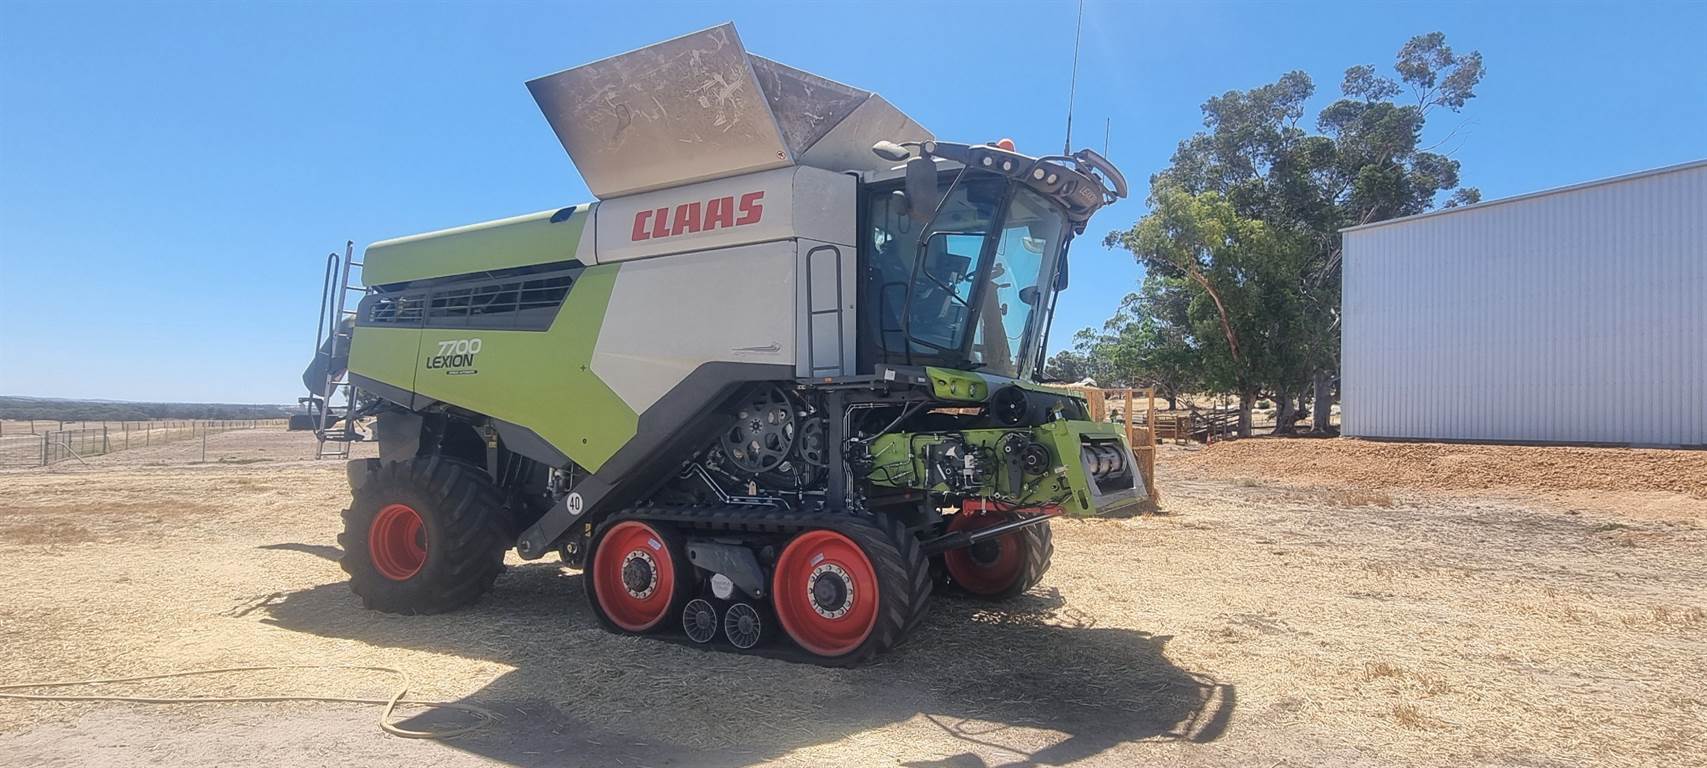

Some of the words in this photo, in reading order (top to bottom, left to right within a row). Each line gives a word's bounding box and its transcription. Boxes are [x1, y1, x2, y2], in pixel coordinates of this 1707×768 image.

[631, 190, 765, 241] CLAAS
[437, 338, 482, 356] 7700
[426, 353, 474, 369] LEXION
[569, 496, 580, 510] 40
